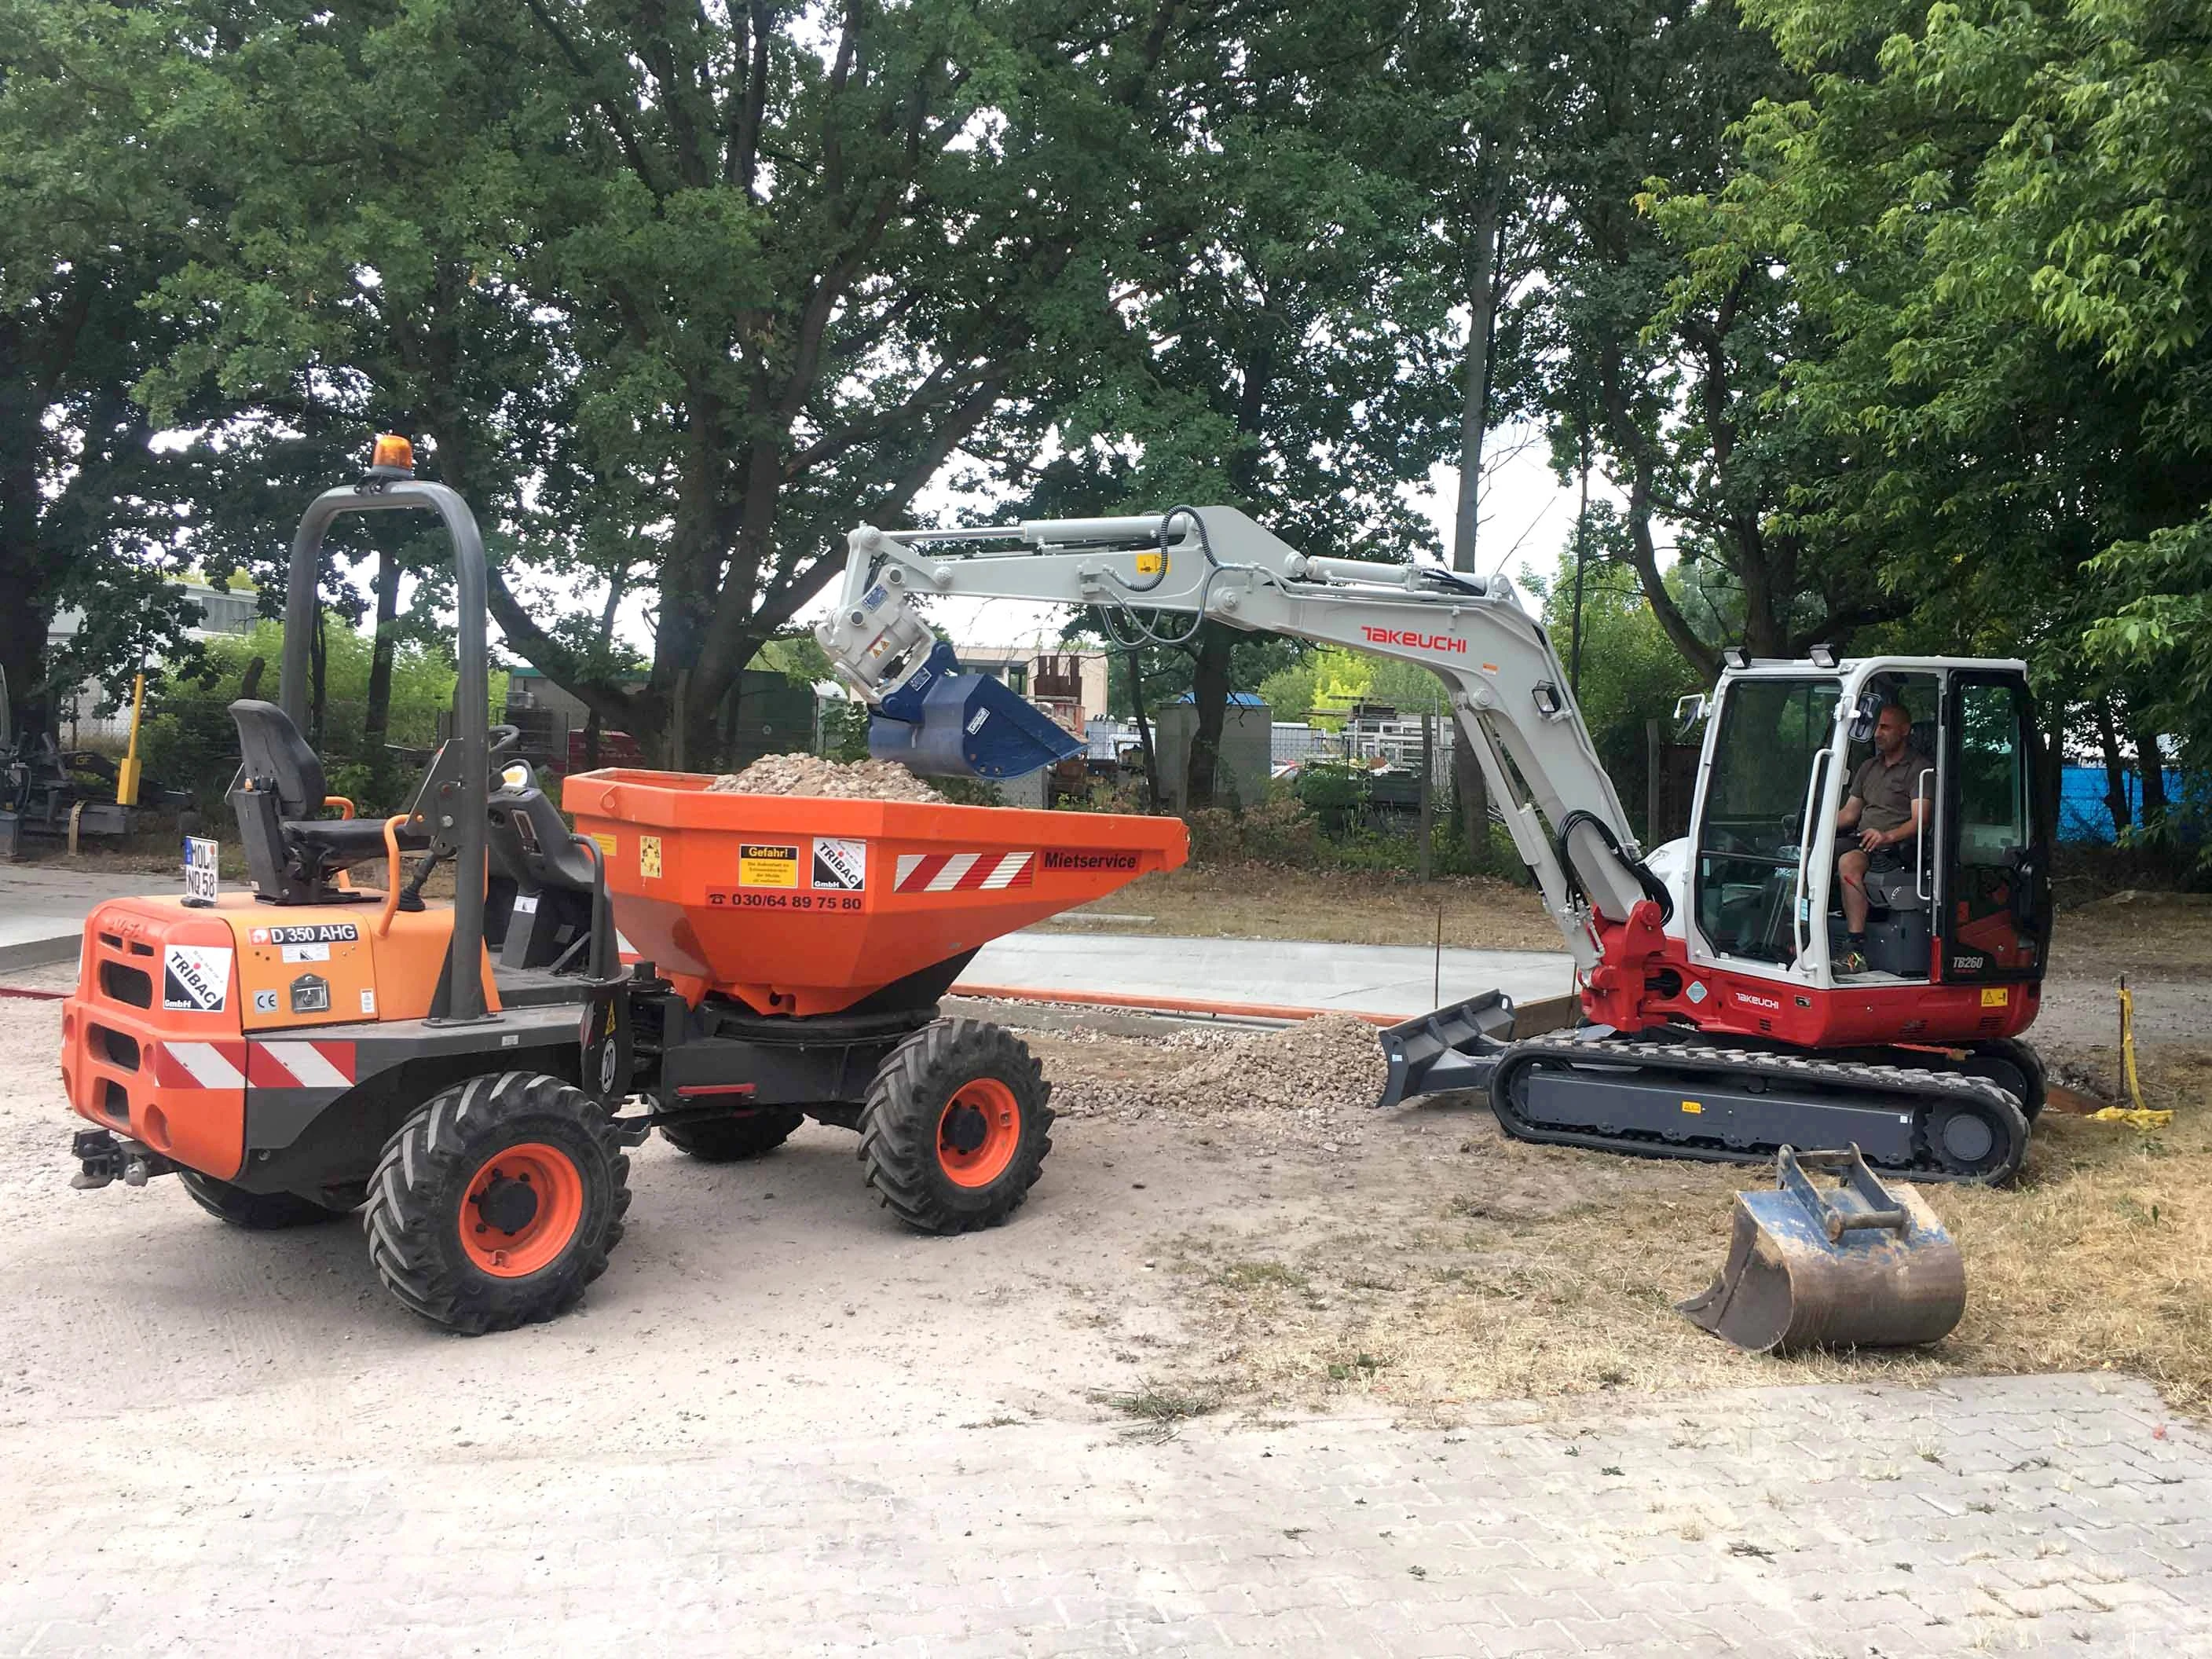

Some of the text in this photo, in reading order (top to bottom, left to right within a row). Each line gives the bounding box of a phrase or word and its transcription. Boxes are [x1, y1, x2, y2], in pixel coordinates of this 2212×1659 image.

[1361, 626, 1467, 654] TAKEUCHI
[749, 847, 789, 858] Gefahr!
[1044, 852, 1137, 868] Mietservice
[819, 842, 859, 884] TRIBAC
[203, 872, 214, 898] 58
[731, 894, 862, 910] 030/64 89 75 80
[270, 925, 355, 943] D 350 AHG
[1953, 957, 1983, 969] TB260
[171, 950, 216, 1003] TRIBAC
[164, 999, 192, 1009] GmbH
[1735, 992, 1779, 1009] TAKEUCHI
